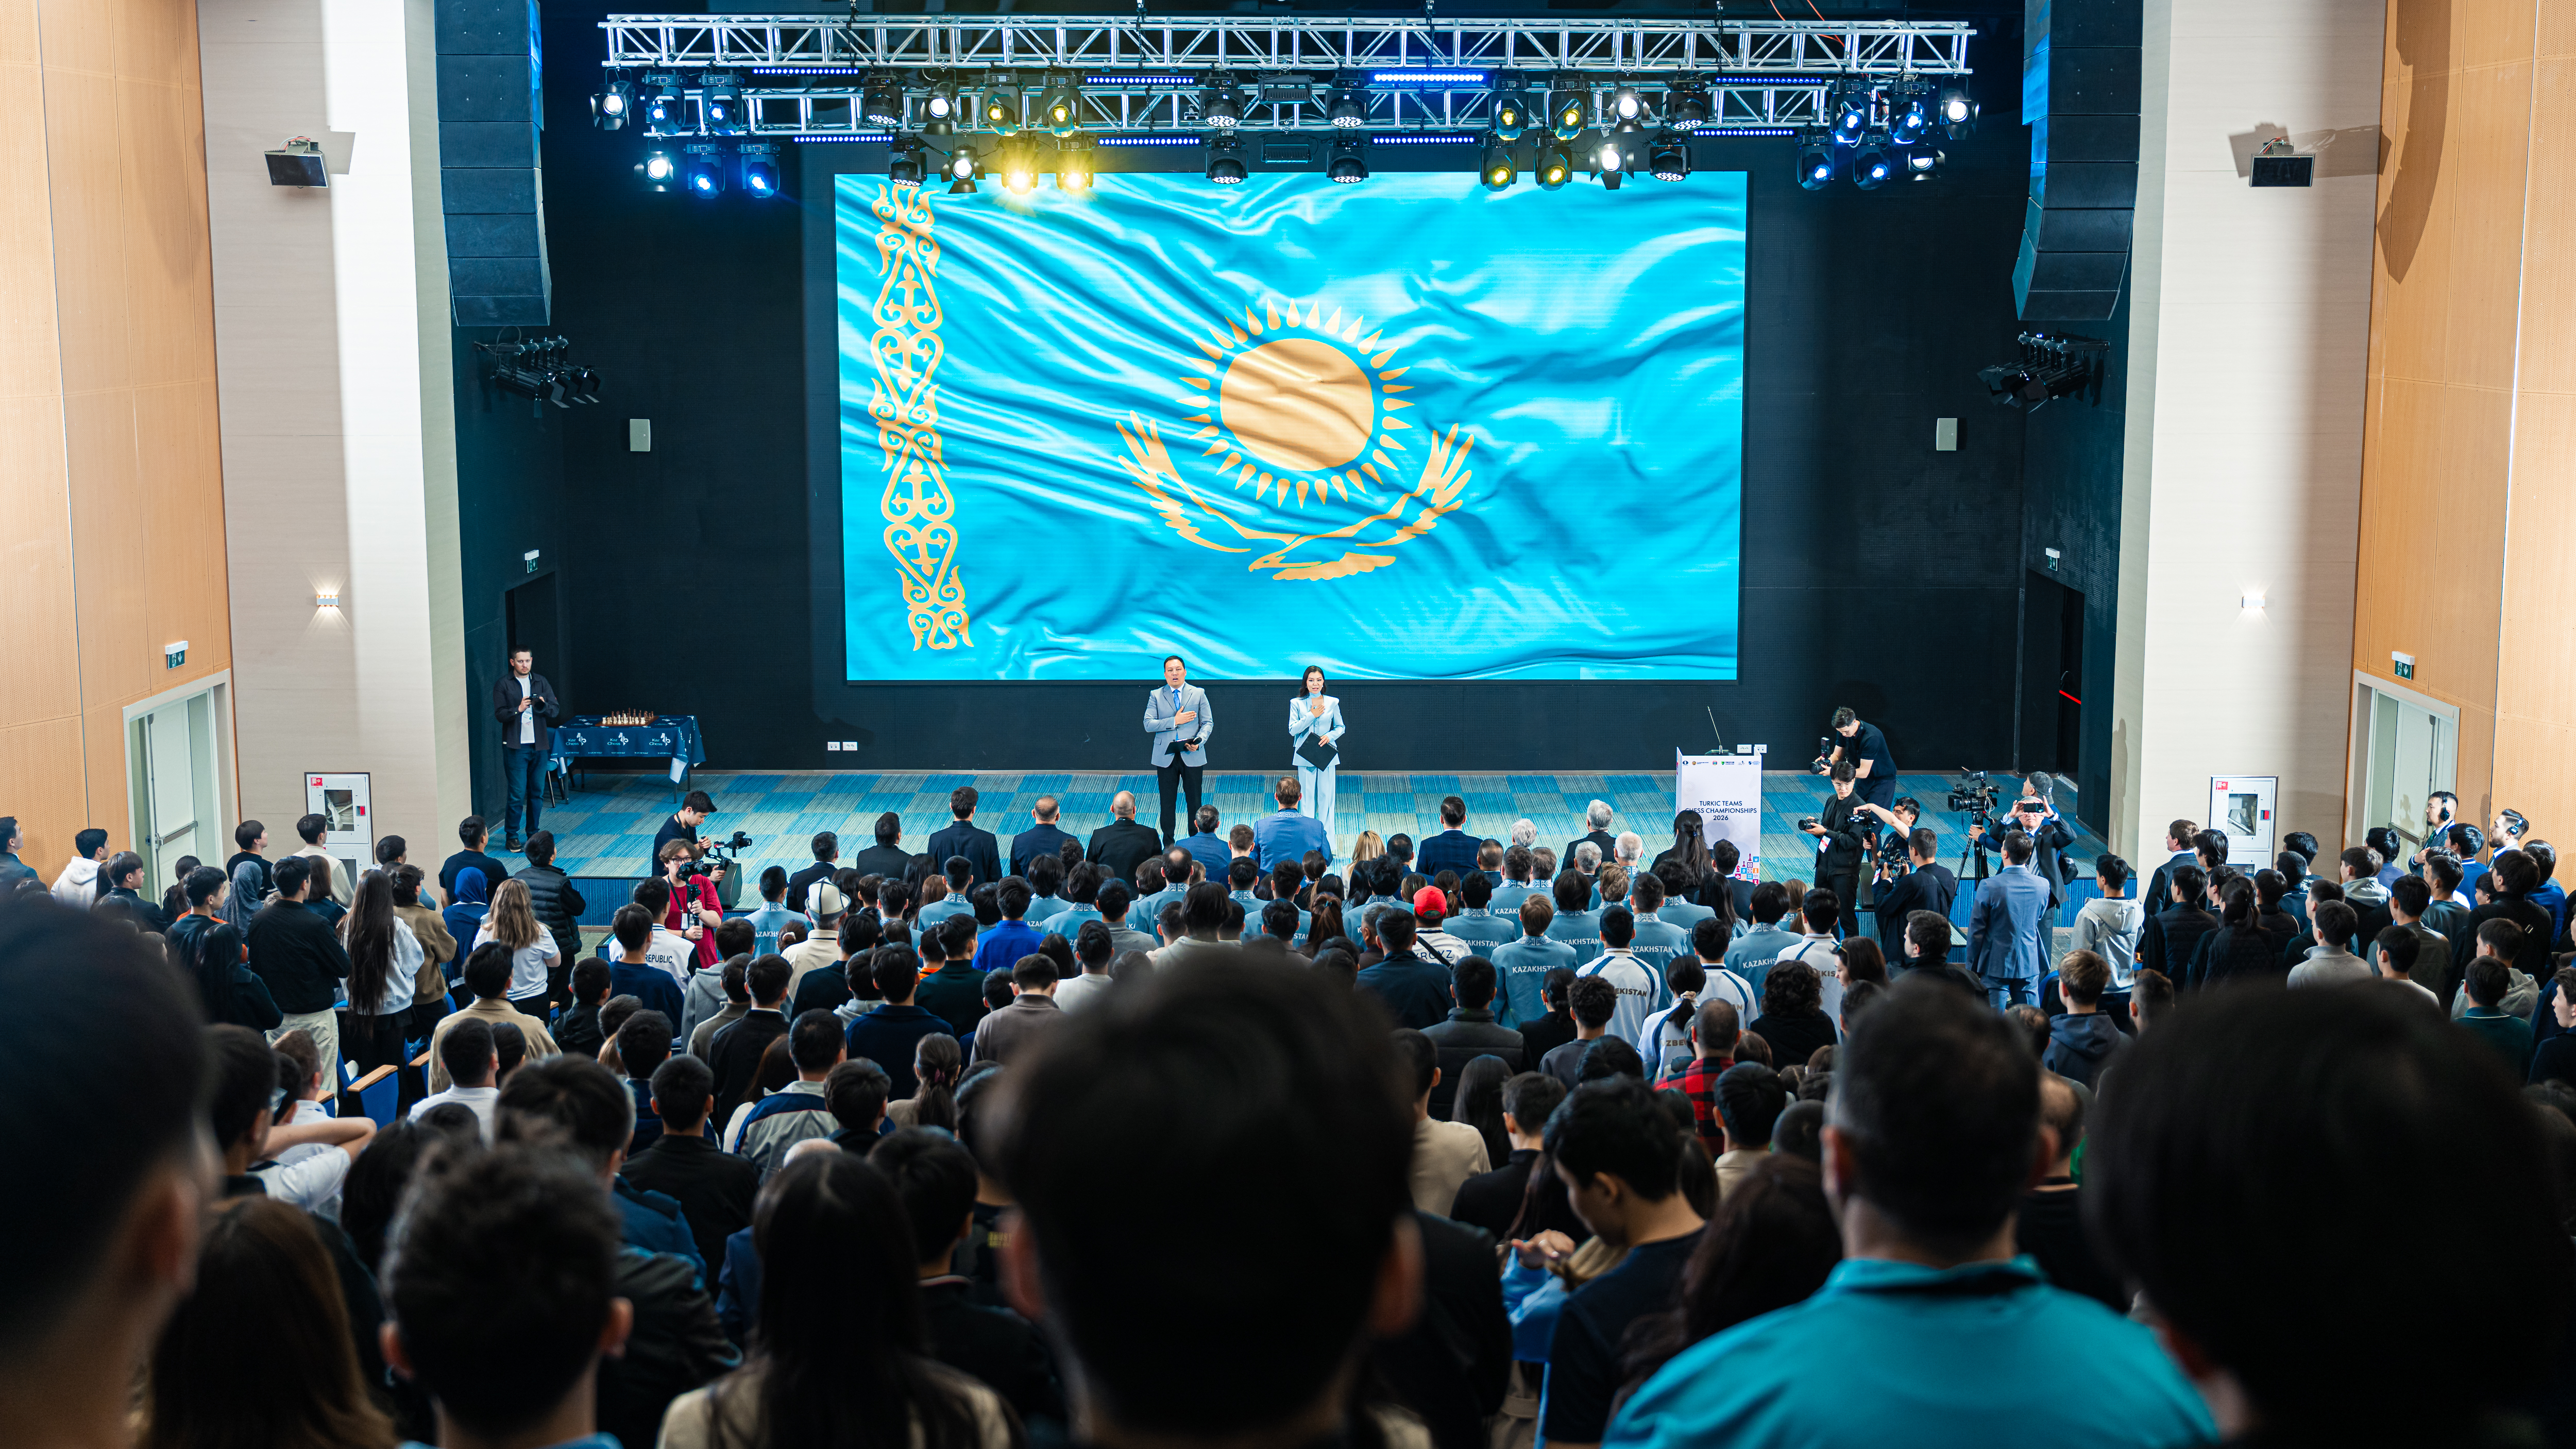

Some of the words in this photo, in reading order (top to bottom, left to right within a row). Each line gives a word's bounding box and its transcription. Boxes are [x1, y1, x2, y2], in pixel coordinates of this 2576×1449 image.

[646, 954, 672, 964] REPUBLIC
[1742, 958, 1777, 969] KAZAKHS
[1615, 987, 1647, 997] EKISTAN
